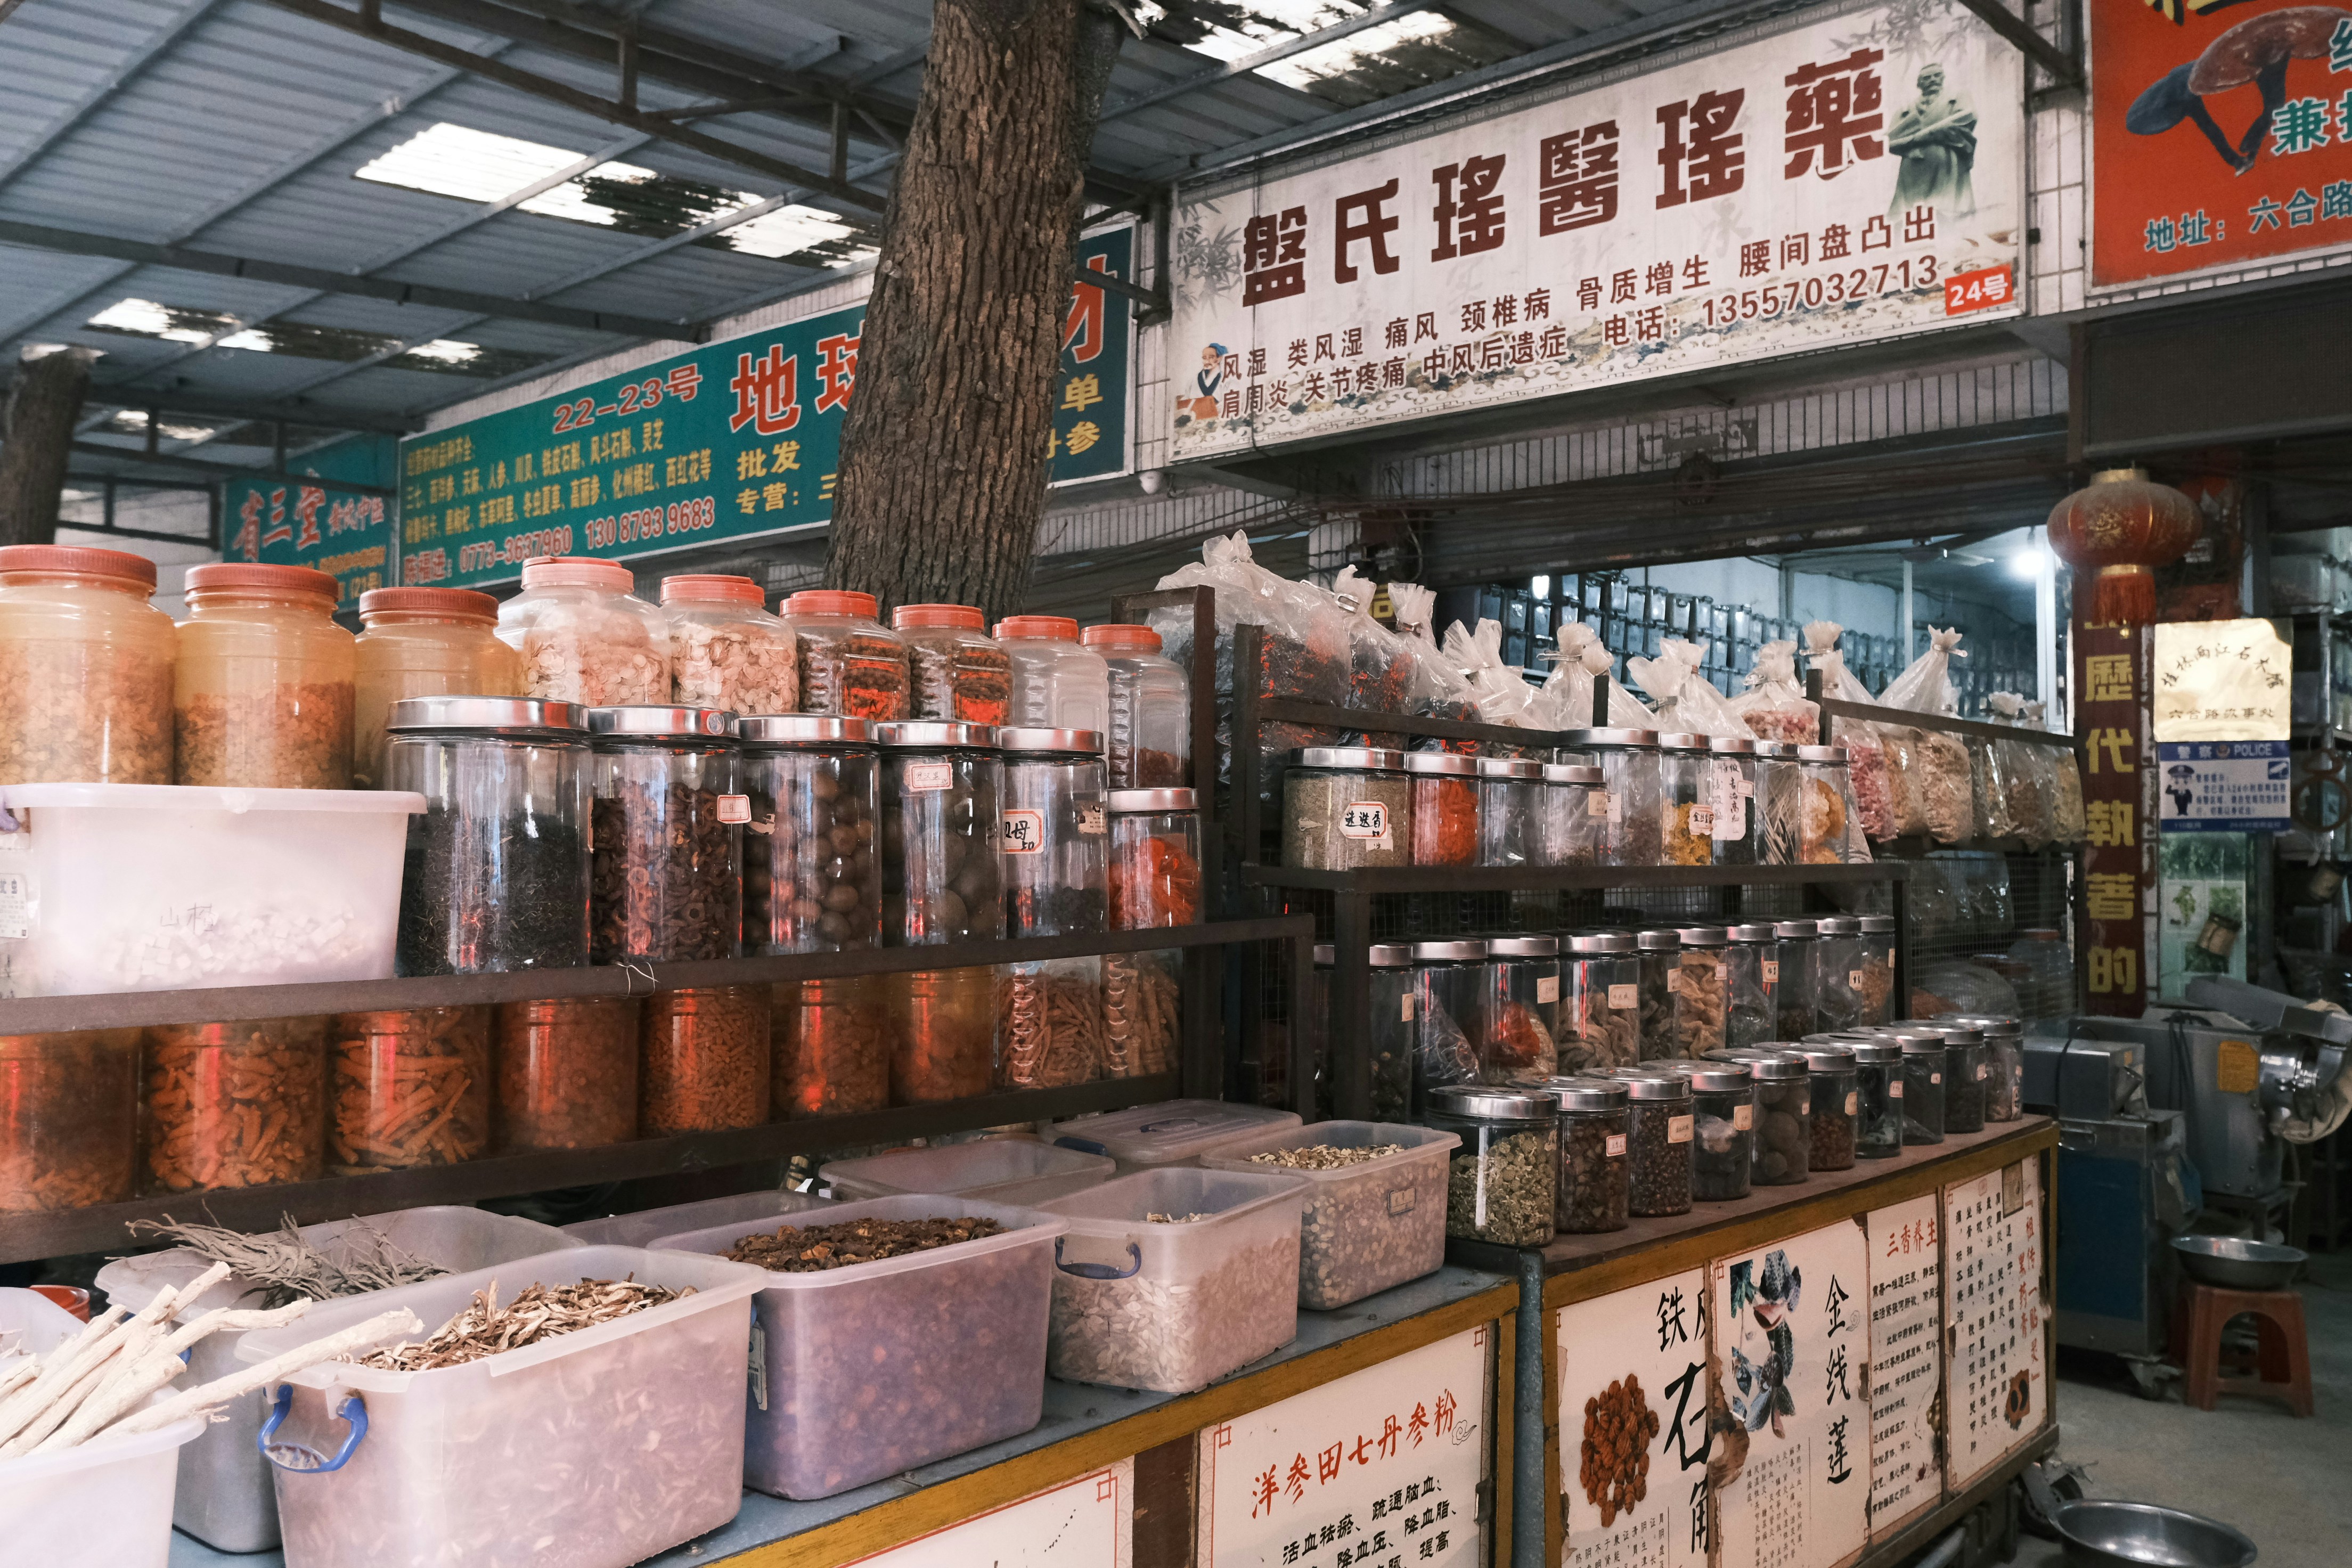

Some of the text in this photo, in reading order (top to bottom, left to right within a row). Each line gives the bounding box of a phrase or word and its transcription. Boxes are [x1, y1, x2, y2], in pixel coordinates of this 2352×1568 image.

[2271, 89, 2352, 156] 兼
[1221, 384, 1290, 420] 肩周炎
[1303, 356, 1408, 406] 关节疼痛
[1423, 326, 1569, 381] 中风后遗症
[1702, 255, 1938, 328] 13557032713
[1222, 205, 1937, 383] 风湿 类风湿 痛风 颈椎病 骨质增生 腰间盘凸出
[1948, 274, 2008, 307] 24号
[737, 373, 1104, 481] 批发 单
[2084, 619, 2136, 994] 歷代執著的
[2234, 742, 2273, 757] POLICE
[1887, 1217, 1938, 1257] 三香养生
[1825, 1273, 1852, 1485] 金线莲
[1251, 1388, 1457, 1520] 洋参田七丹参粉
